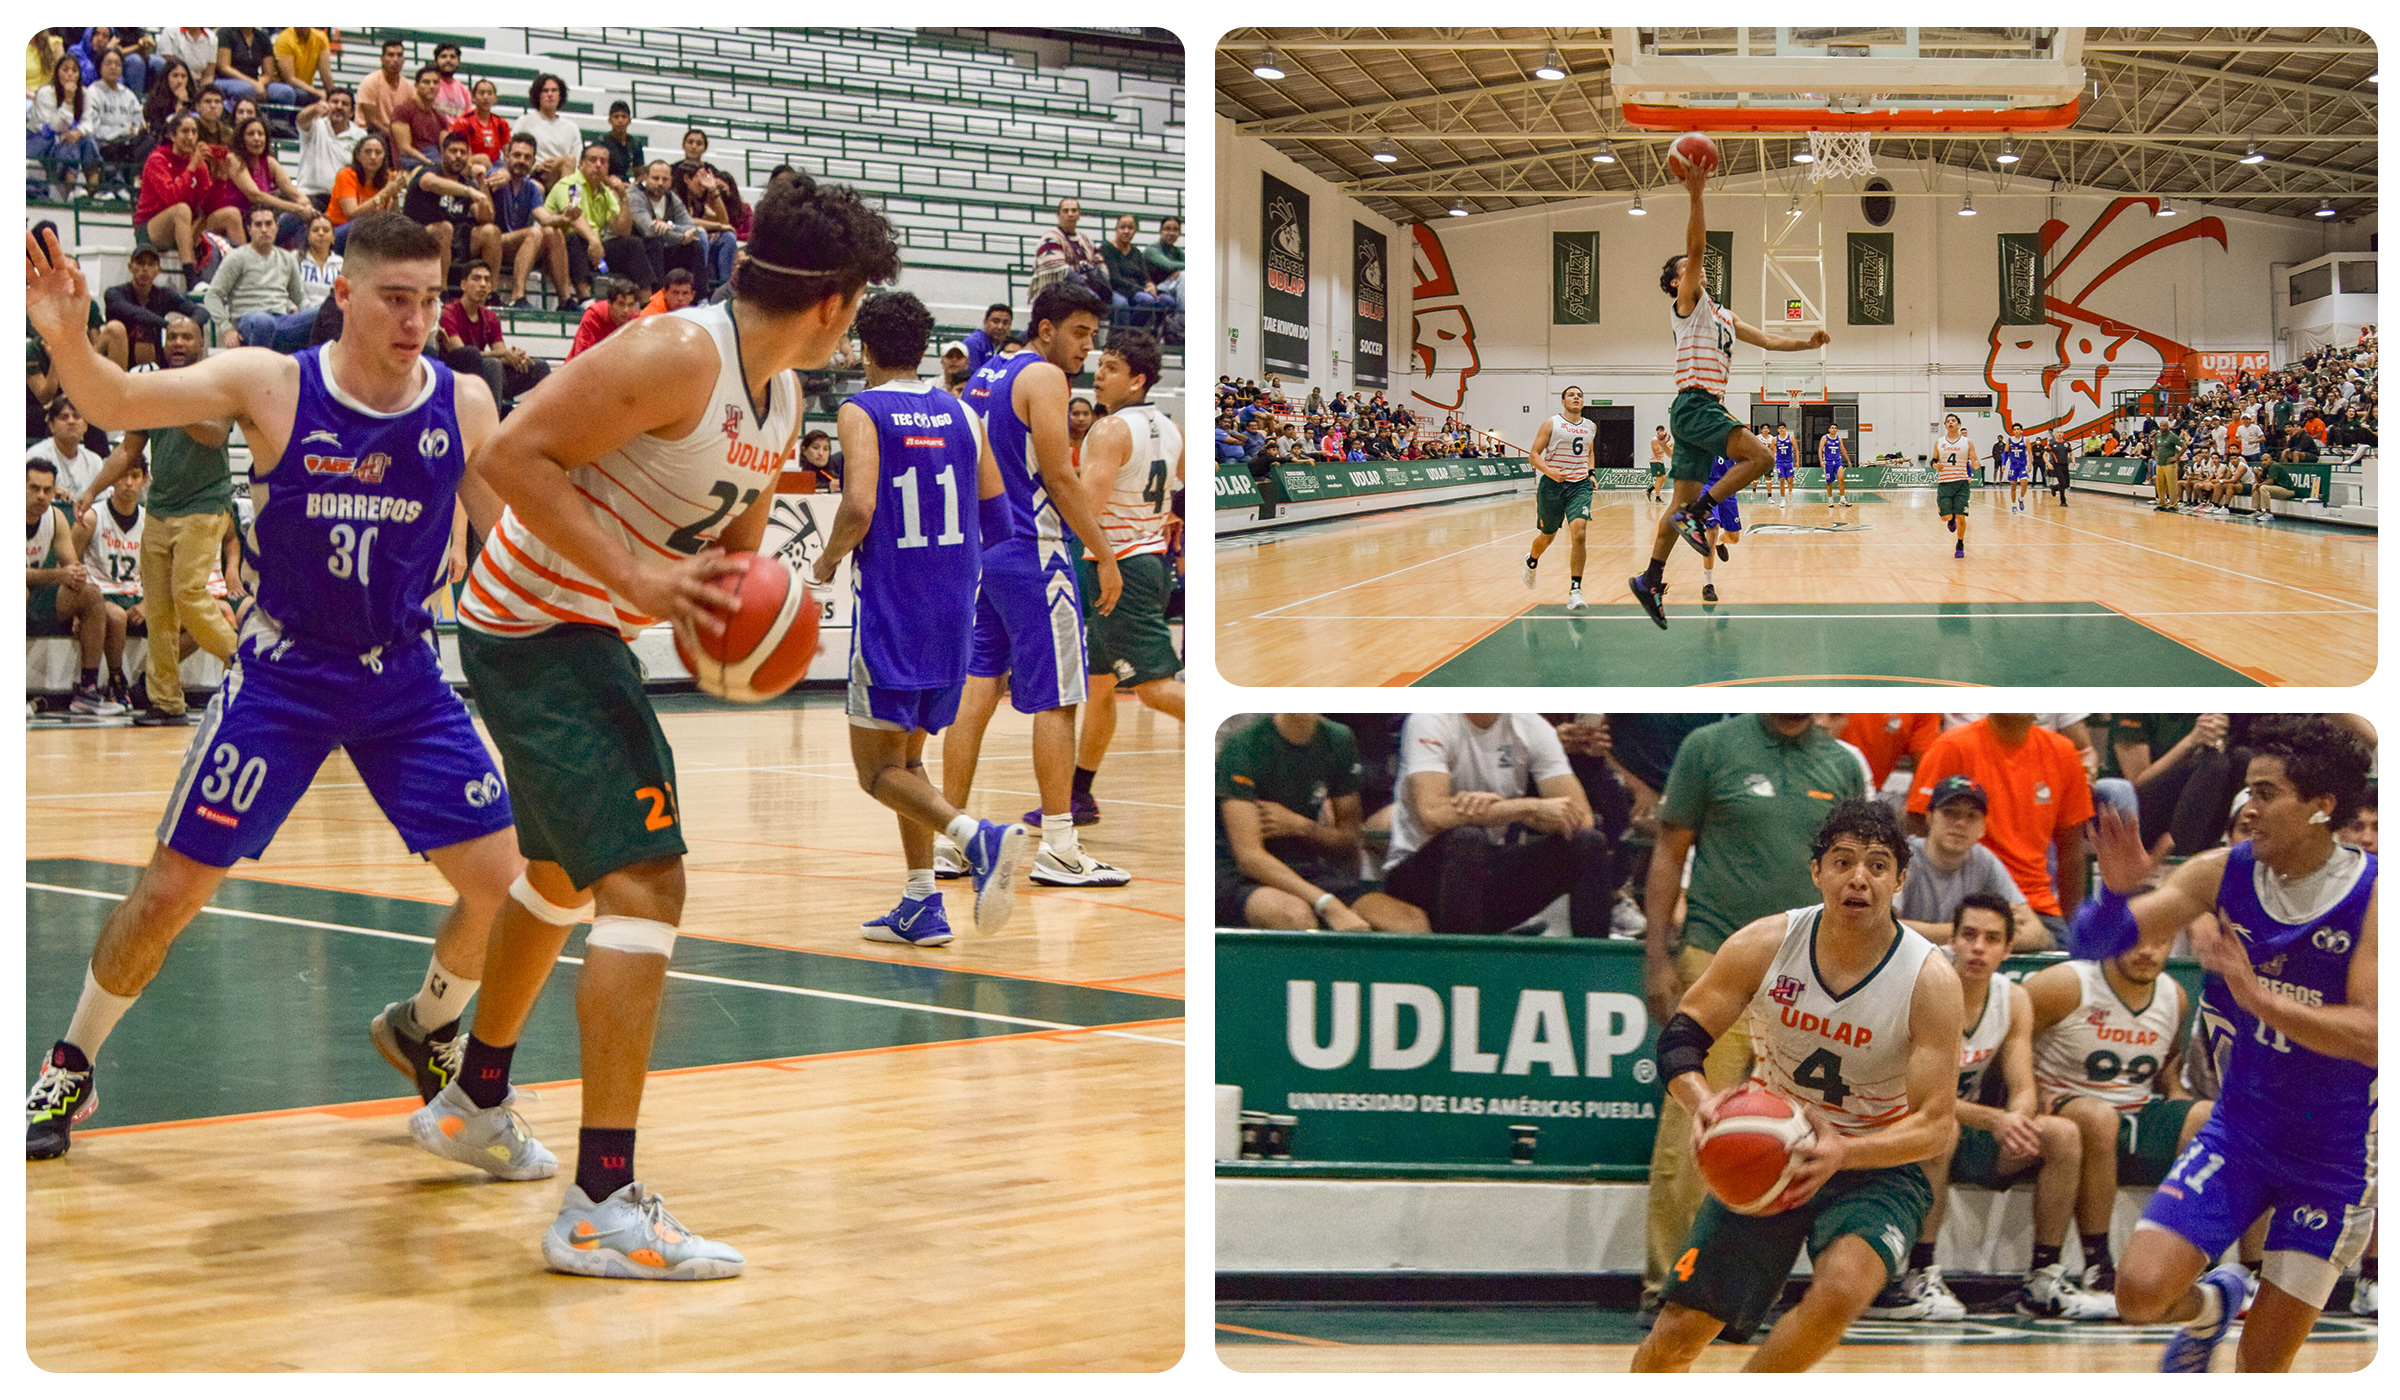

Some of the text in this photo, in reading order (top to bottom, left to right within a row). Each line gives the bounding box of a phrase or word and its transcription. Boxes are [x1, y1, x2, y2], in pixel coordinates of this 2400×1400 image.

[1267, 267, 1305, 297] UDLAP
[1569, 245, 1585, 316] AZTECAS
[1863, 245, 1879, 316] AZTECAS
[2014, 245, 2030, 316] AZTECAS
[1263, 316, 1309, 341] TAE KWON DO
[1715, 321, 1733, 358] 12
[1360, 339, 1383, 356] SOCCER
[2202, 355, 2268, 370] UDLAP
[891, 413, 914, 426] TEC
[726, 440, 779, 476] UDLAP
[1572, 436, 1584, 456] 6
[1947, 453, 1957, 466] 4
[1143, 459, 1167, 514] 4
[306, 493, 422, 524] BORREGOS
[893, 464, 964, 549] 11
[108, 554, 136, 581] 12
[202, 743, 267, 812] 30
[635, 781, 679, 831] 2
[1781, 1006, 1873, 1048] UDLAP
[2097, 1023, 2159, 1045] UDLAP
[1793, 1047, 1850, 1107] 4
[1287, 1092, 1656, 1119] UNIVERSIDAD DE LAS AMÉRICAS PUEBLA
[1674, 1247, 1699, 1281] 4
